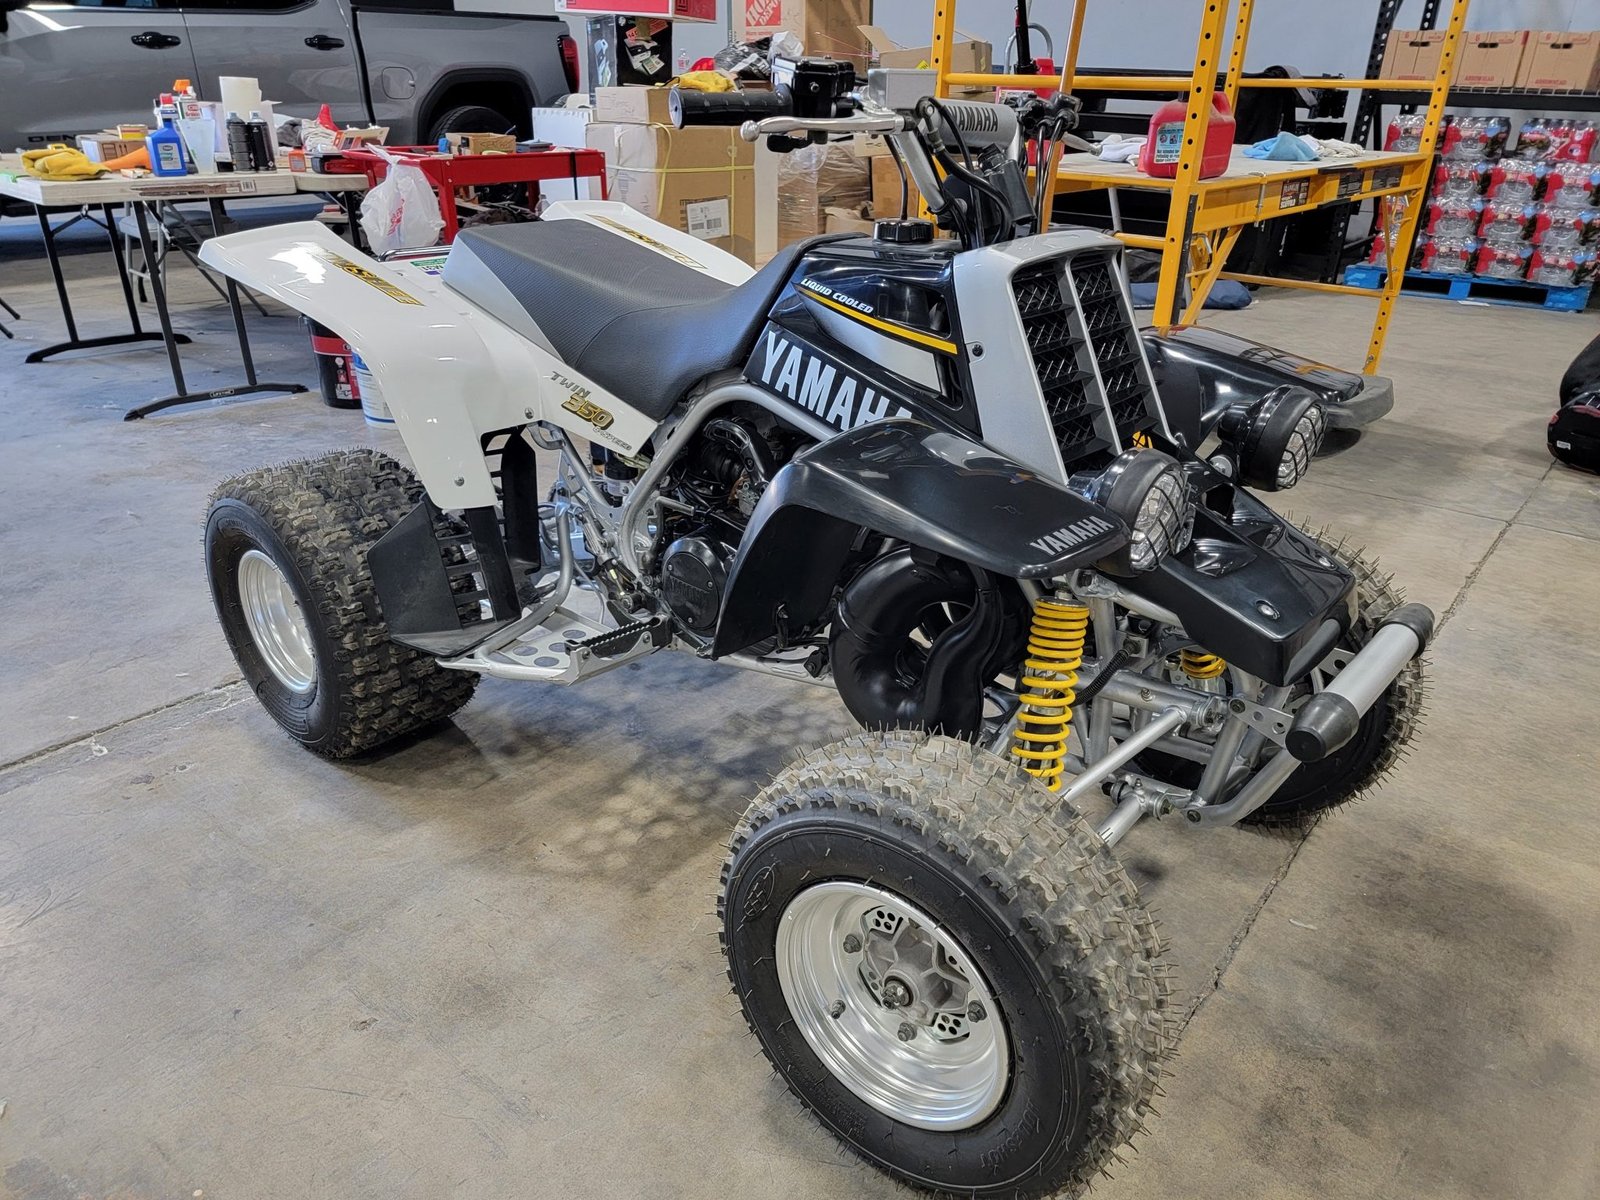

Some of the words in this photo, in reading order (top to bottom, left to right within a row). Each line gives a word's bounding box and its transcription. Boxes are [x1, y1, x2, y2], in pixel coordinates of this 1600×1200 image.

[944, 105, 998, 132] YAMAHA
[801, 278, 832, 296] LIQUID
[832, 292, 874, 314] COOLED
[550, 371, 591, 398] TWIN
[561, 392, 615, 430] 350
[1030, 515, 1114, 555] YAMAHA
